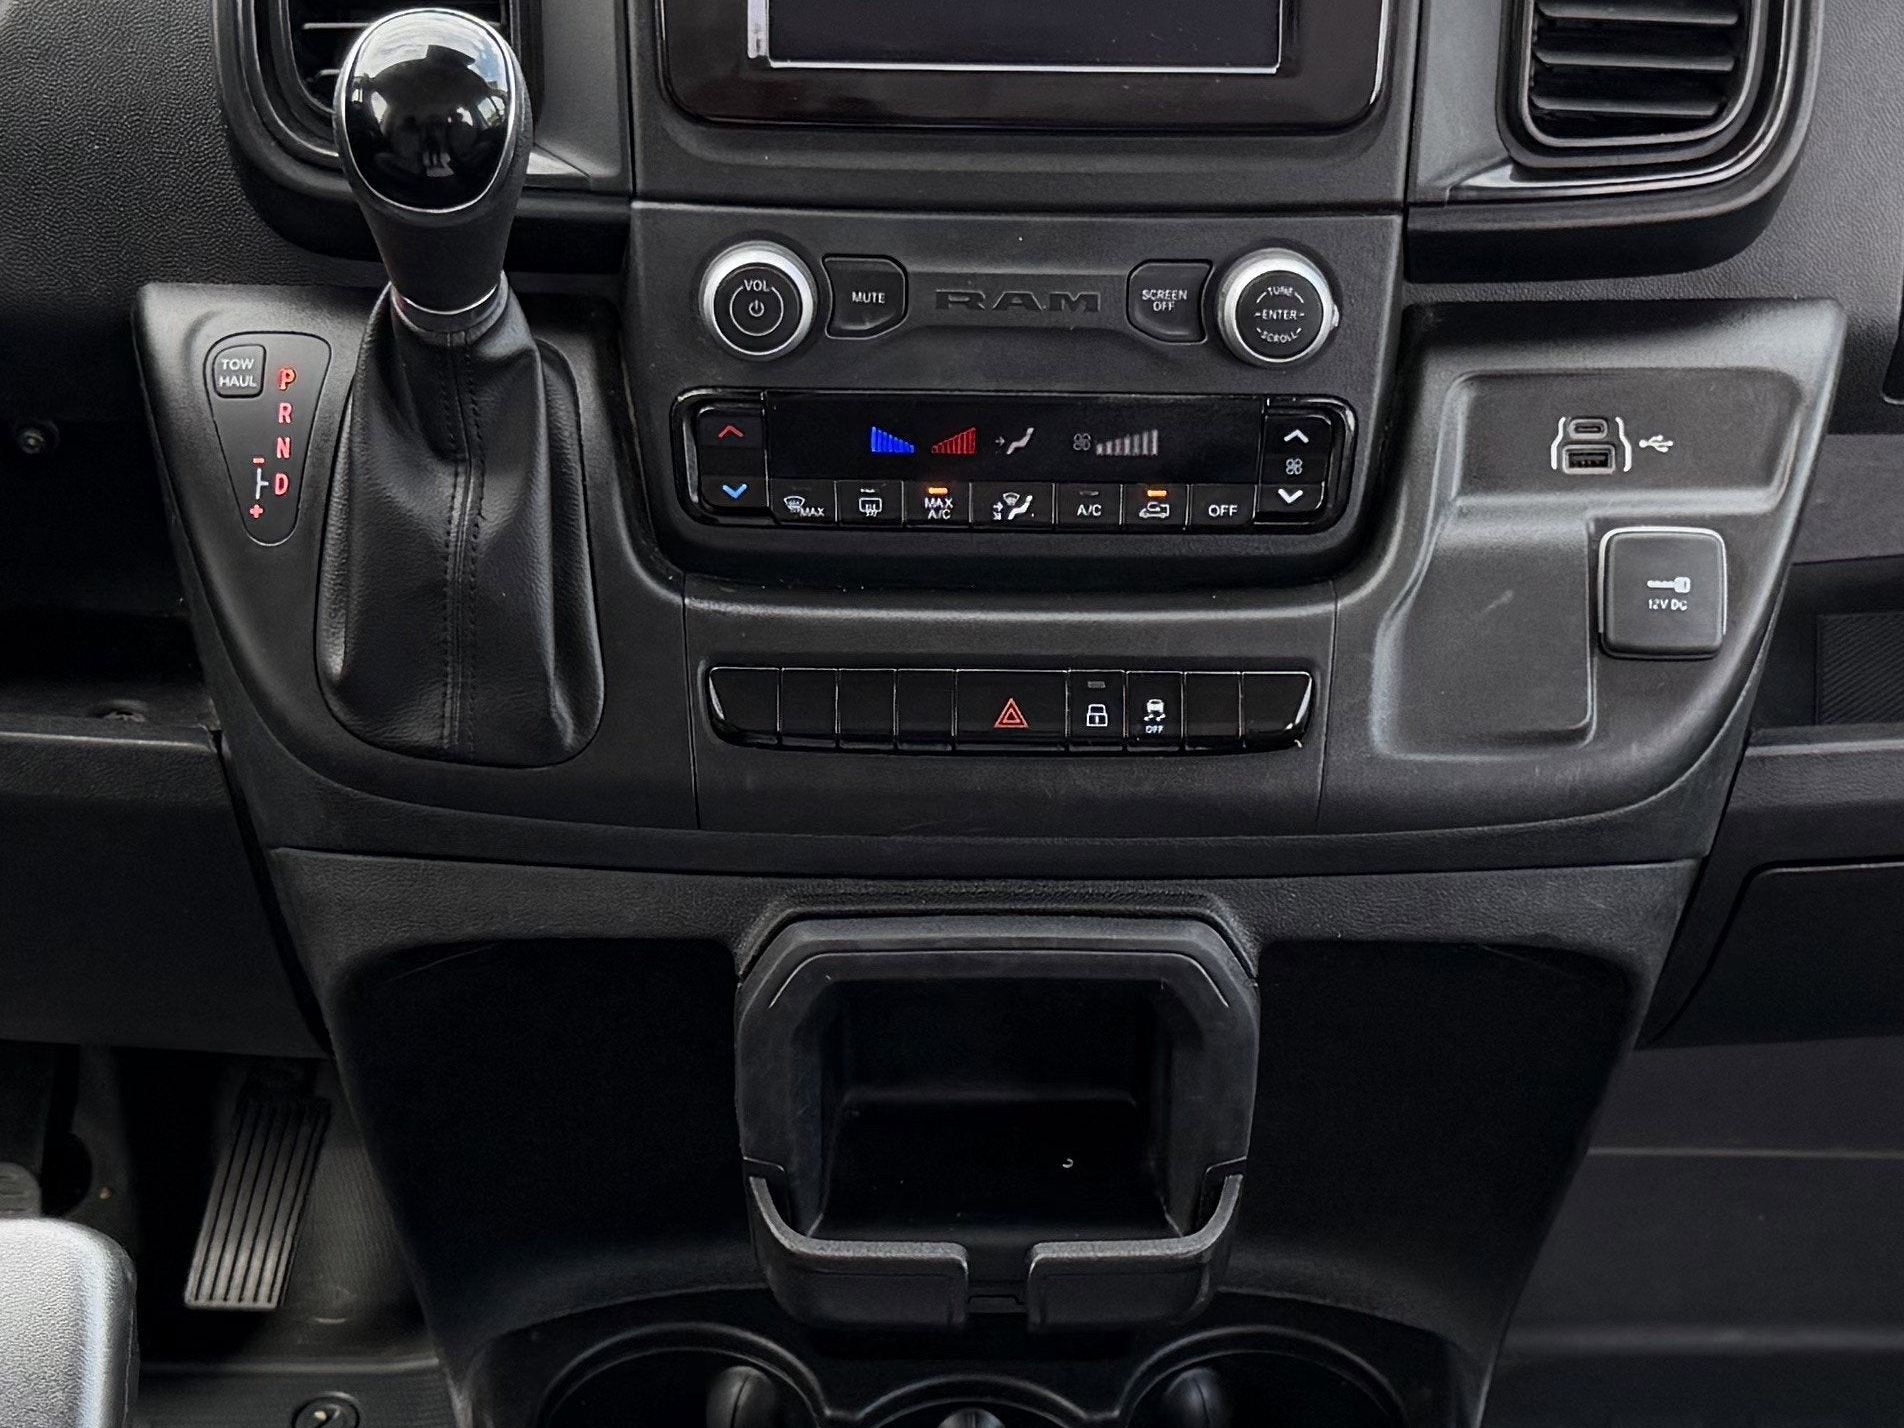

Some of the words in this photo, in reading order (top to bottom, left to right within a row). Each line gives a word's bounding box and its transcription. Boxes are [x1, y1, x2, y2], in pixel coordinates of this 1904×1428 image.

[744, 279, 770, 293] VOL
[852, 291, 886, 304] MUTE
[934, 288, 1101, 312] RAM
[1141, 288, 1188, 301] SCREEN
[1153, 300, 1175, 312] OFF
[1262, 308, 1297, 320] ENTER
[1260, 329, 1296, 343] SCROLL
[221, 358, 255, 371] TOW
[218, 374, 257, 388] HAUL
[278, 367, 296, 391] P
[278, 403, 292, 425] R
[276, 436, 291, 459] N
[274, 473, 289, 495] D
[924, 496, 954, 509] MAX
[799, 506, 825, 518] MAX
[927, 508, 952, 520] A/C
[1077, 503, 1102, 517] A/C
[1208, 503, 1238, 518] OFF
[1648, 598, 1669, 610] 12V
[1670, 598, 1688, 611] DC
[1145, 724, 1164, 734] OFF
